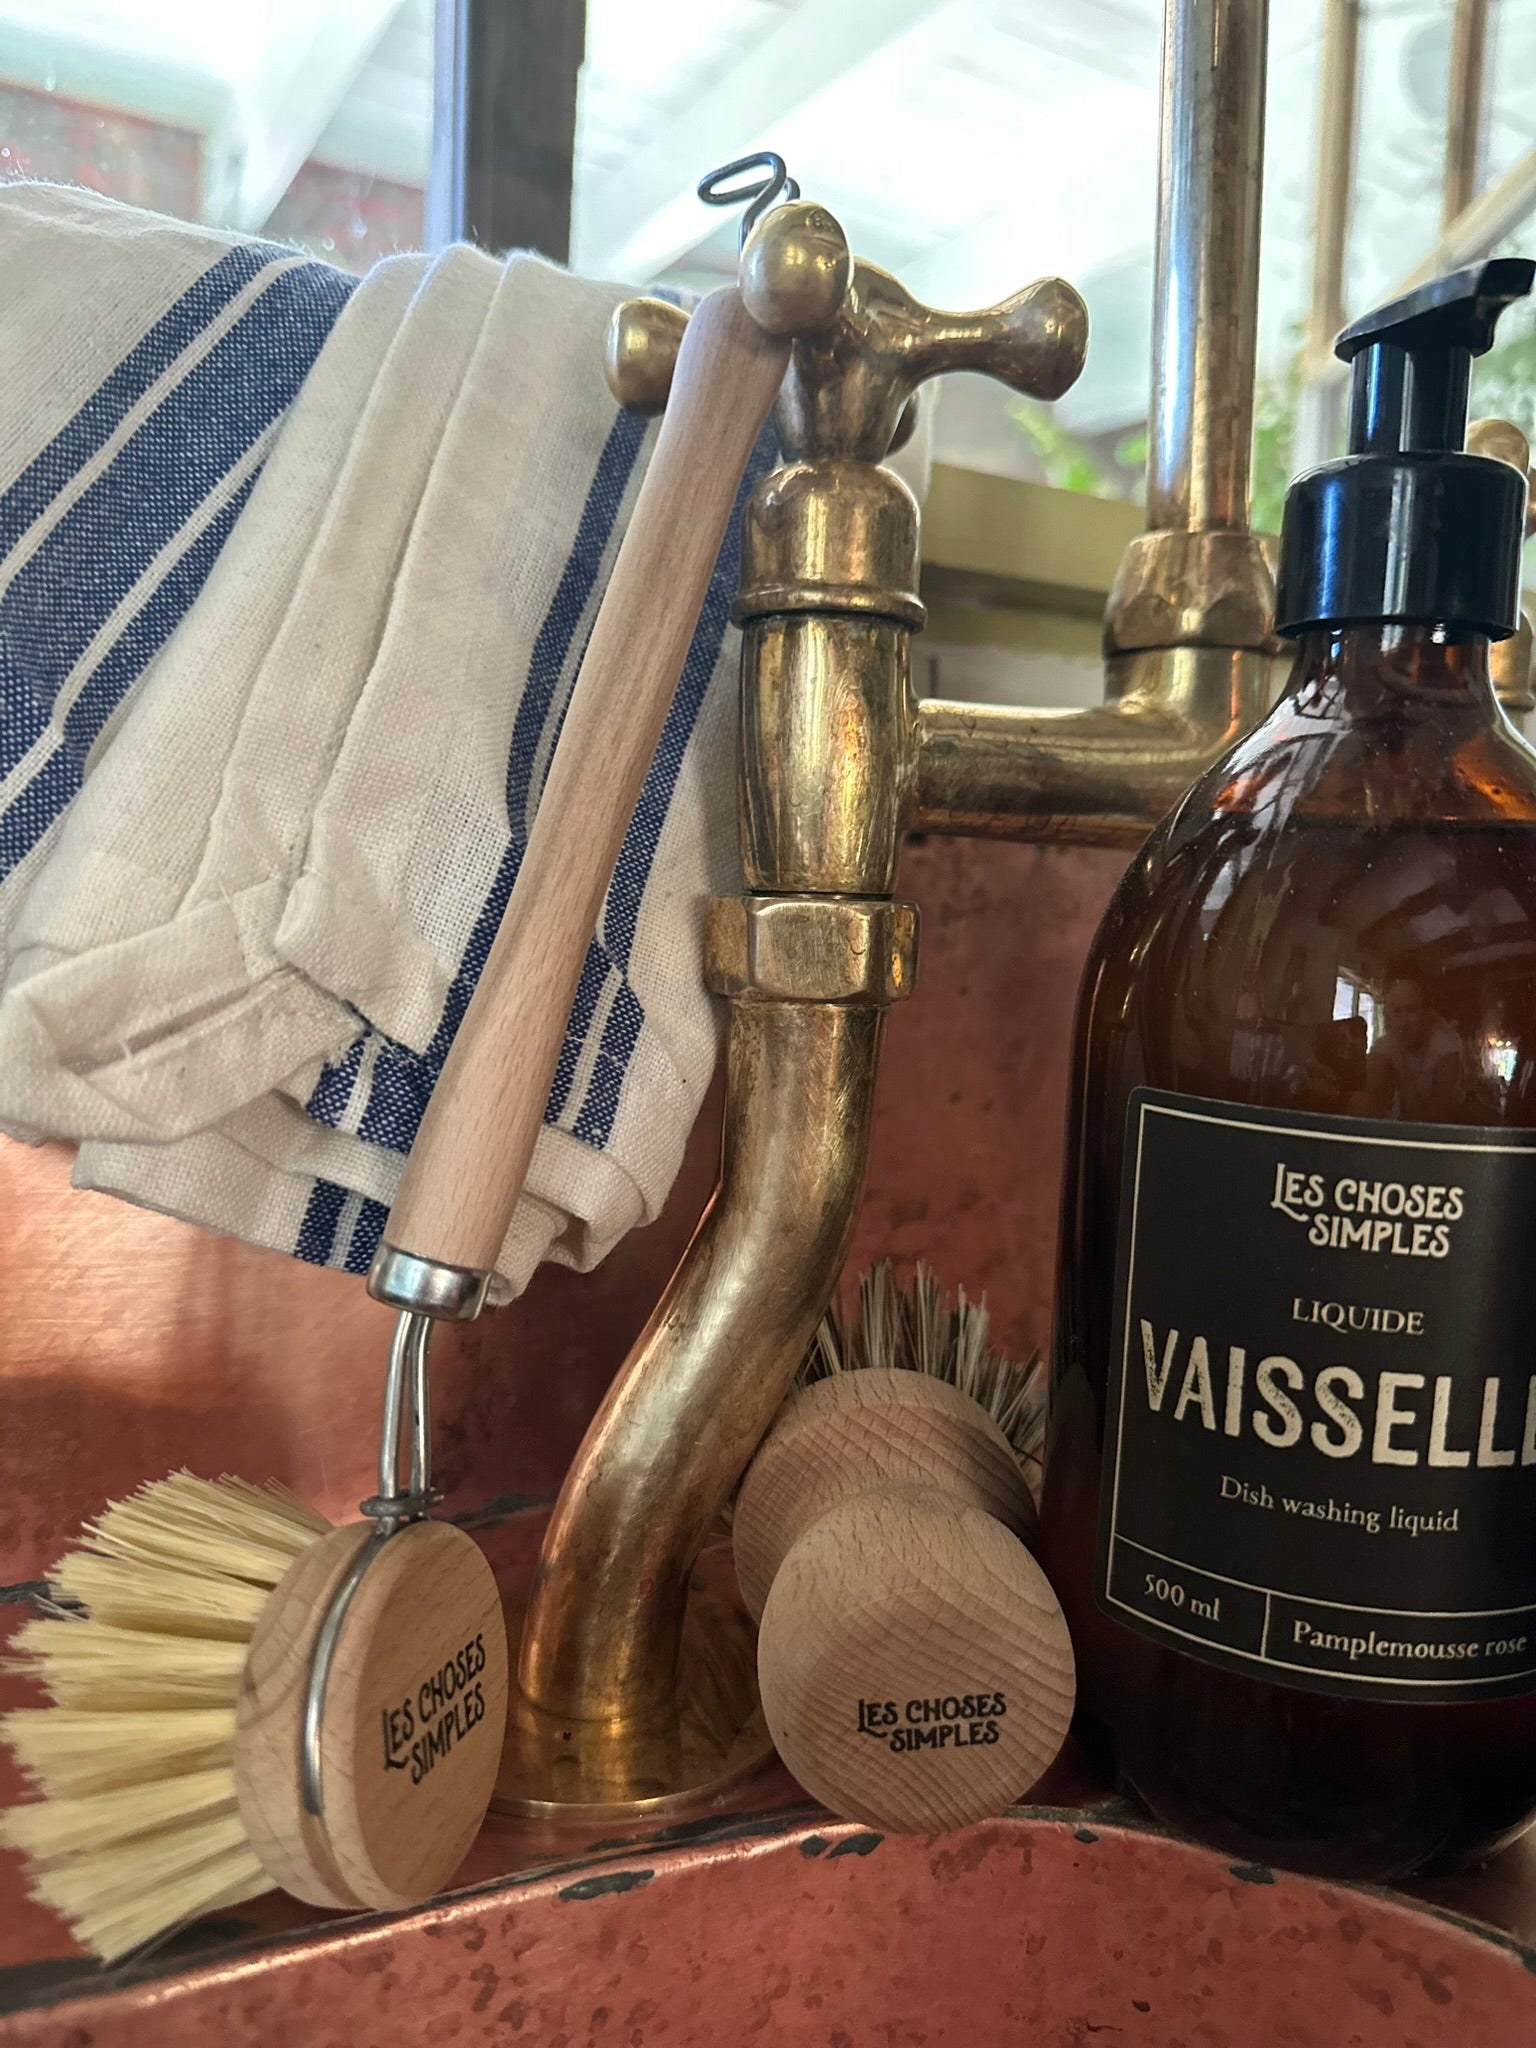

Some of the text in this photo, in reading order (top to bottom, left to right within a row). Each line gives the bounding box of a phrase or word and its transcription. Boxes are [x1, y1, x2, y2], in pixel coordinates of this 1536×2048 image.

[1271, 1163, 1464, 1222] LES CHOSES
[1308, 1212, 1450, 1258] SIMPLES
[1292, 1298, 1425, 1335] LIQUIDE
[1219, 1475, 1460, 1537] Dish washing liquid
[1144, 1573, 1220, 1622] 500 ml
[1293, 1620, 1527, 1660] Pamplemousse rose
[382, 1633, 486, 1771] LES CHOSES
[857, 1692, 1007, 1739] LES CHOSES
[411, 1682, 485, 1785] SIMPLES
[889, 1720, 1000, 1752] SIMPLES
